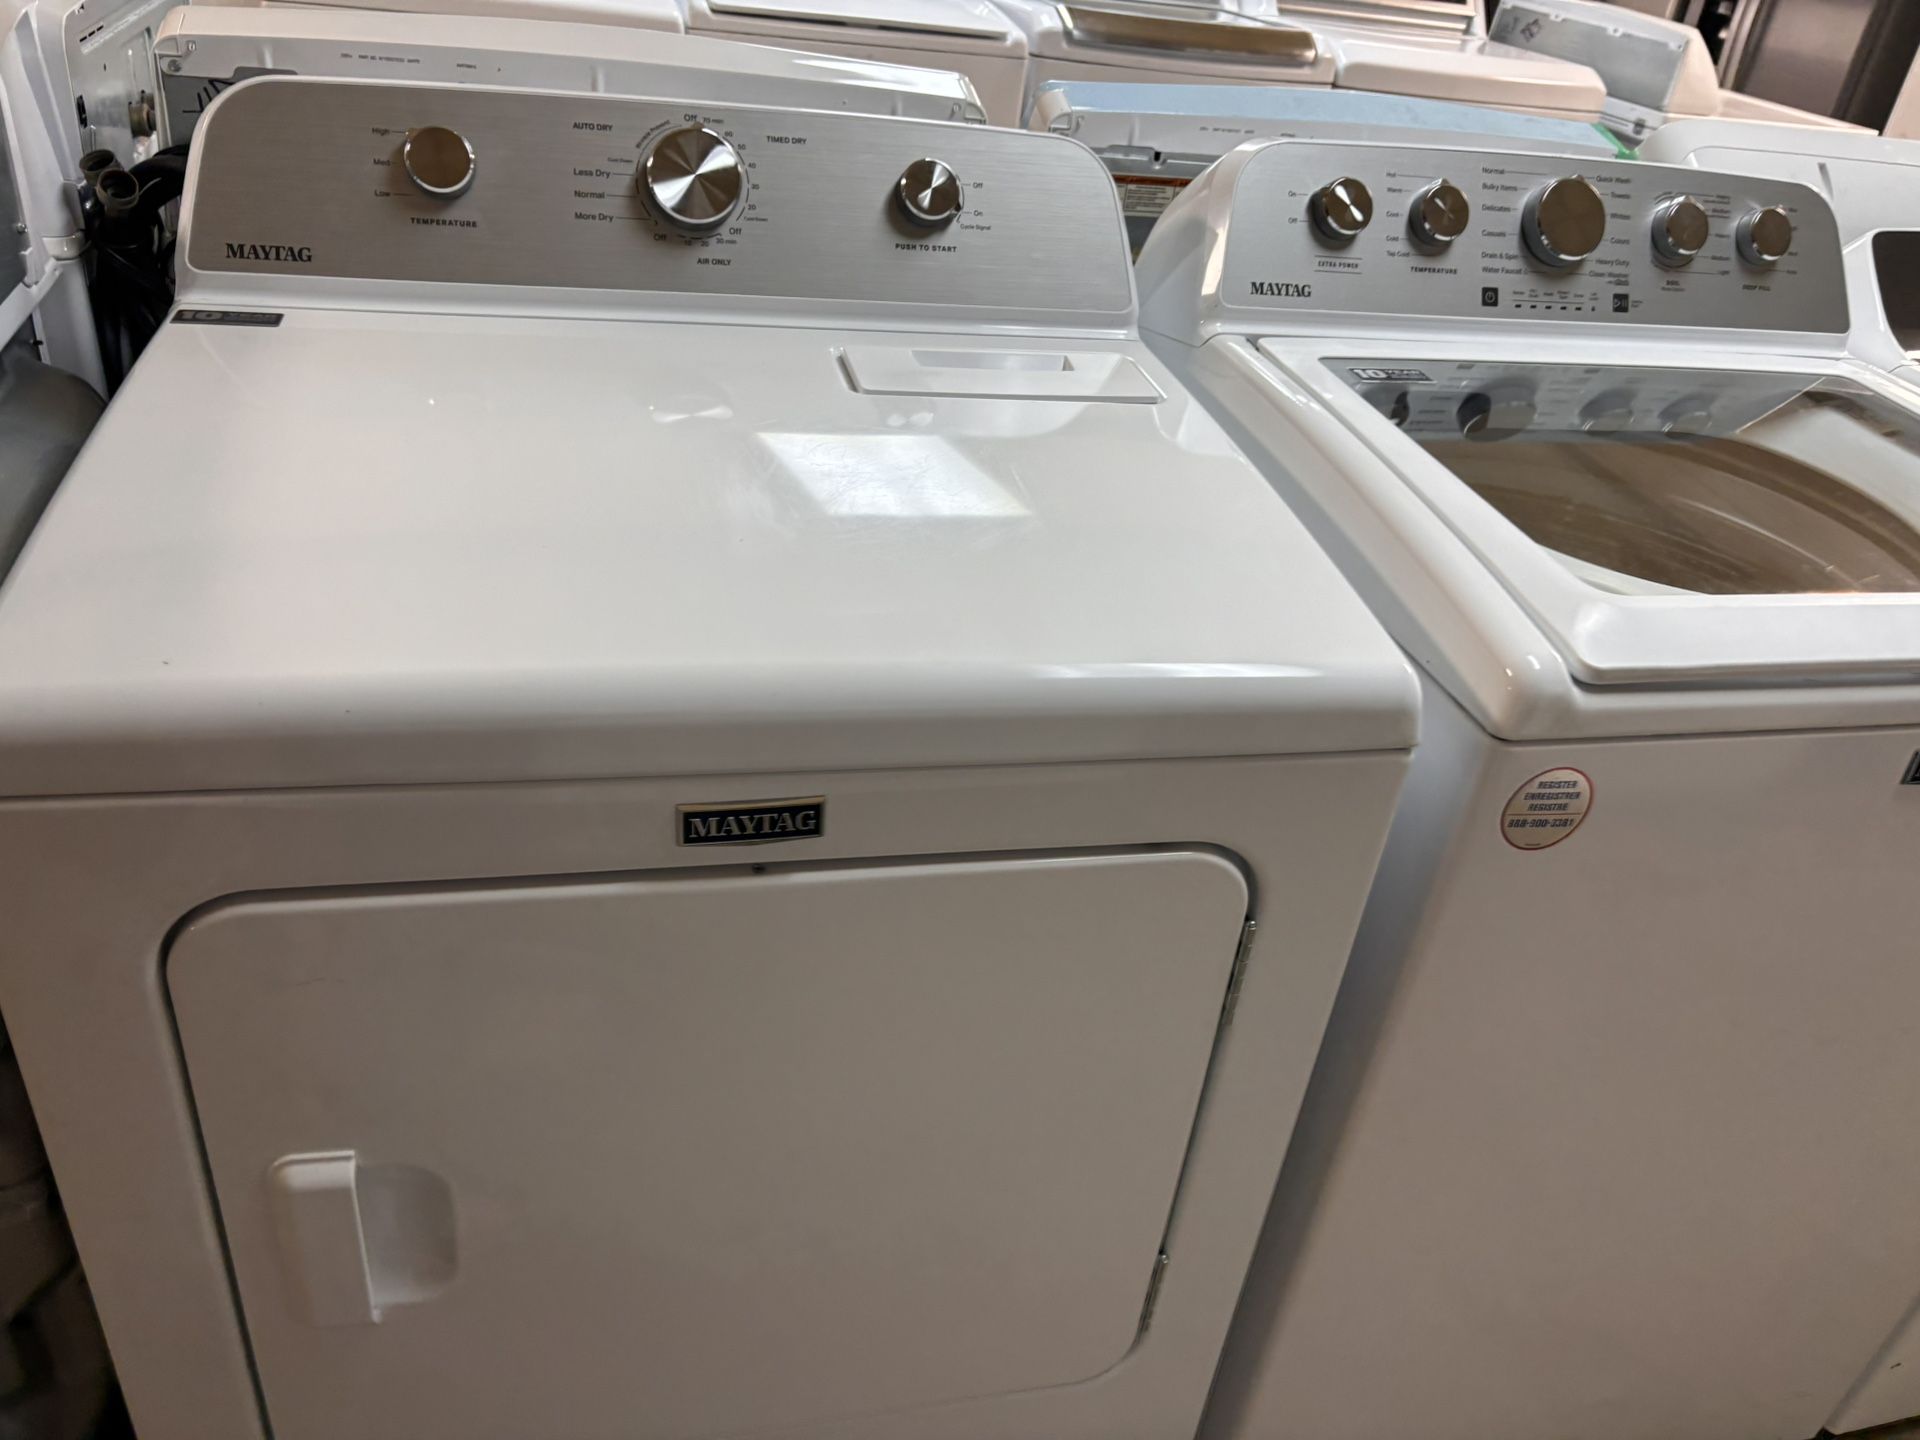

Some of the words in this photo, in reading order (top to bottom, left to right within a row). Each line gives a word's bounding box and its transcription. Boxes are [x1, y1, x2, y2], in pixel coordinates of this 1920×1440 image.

[684, 114, 697, 122] Off
[573, 122, 594, 131] AUTO
[596, 123, 613, 132] DRY
[372, 128, 390, 136] High
[766, 135, 790, 144] TIMED
[792, 136, 807, 145] DRY
[573, 168, 592, 177] Less
[595, 170, 611, 180] Dry
[574, 190, 605, 199] Normal
[575, 212, 596, 221] More
[598, 214, 614, 223] Dry
[410, 217, 478, 228] TEMPERATURE
[729, 227, 742, 235] Off
[654, 233, 667, 241] Off
[226, 243, 312, 262] MAYTAG
[1410, 266, 1458, 275] TEMPERATURE
[1250, 282, 1311, 297] MAYTAG
[1354, 370, 1386, 378] 10
[1537, 781, 1578, 789] REGISTER
[1524, 792, 1582, 800] ENREGISTRER
[1528, 803, 1568, 812] REGISTRE
[689, 810, 817, 838] MAYTAG
